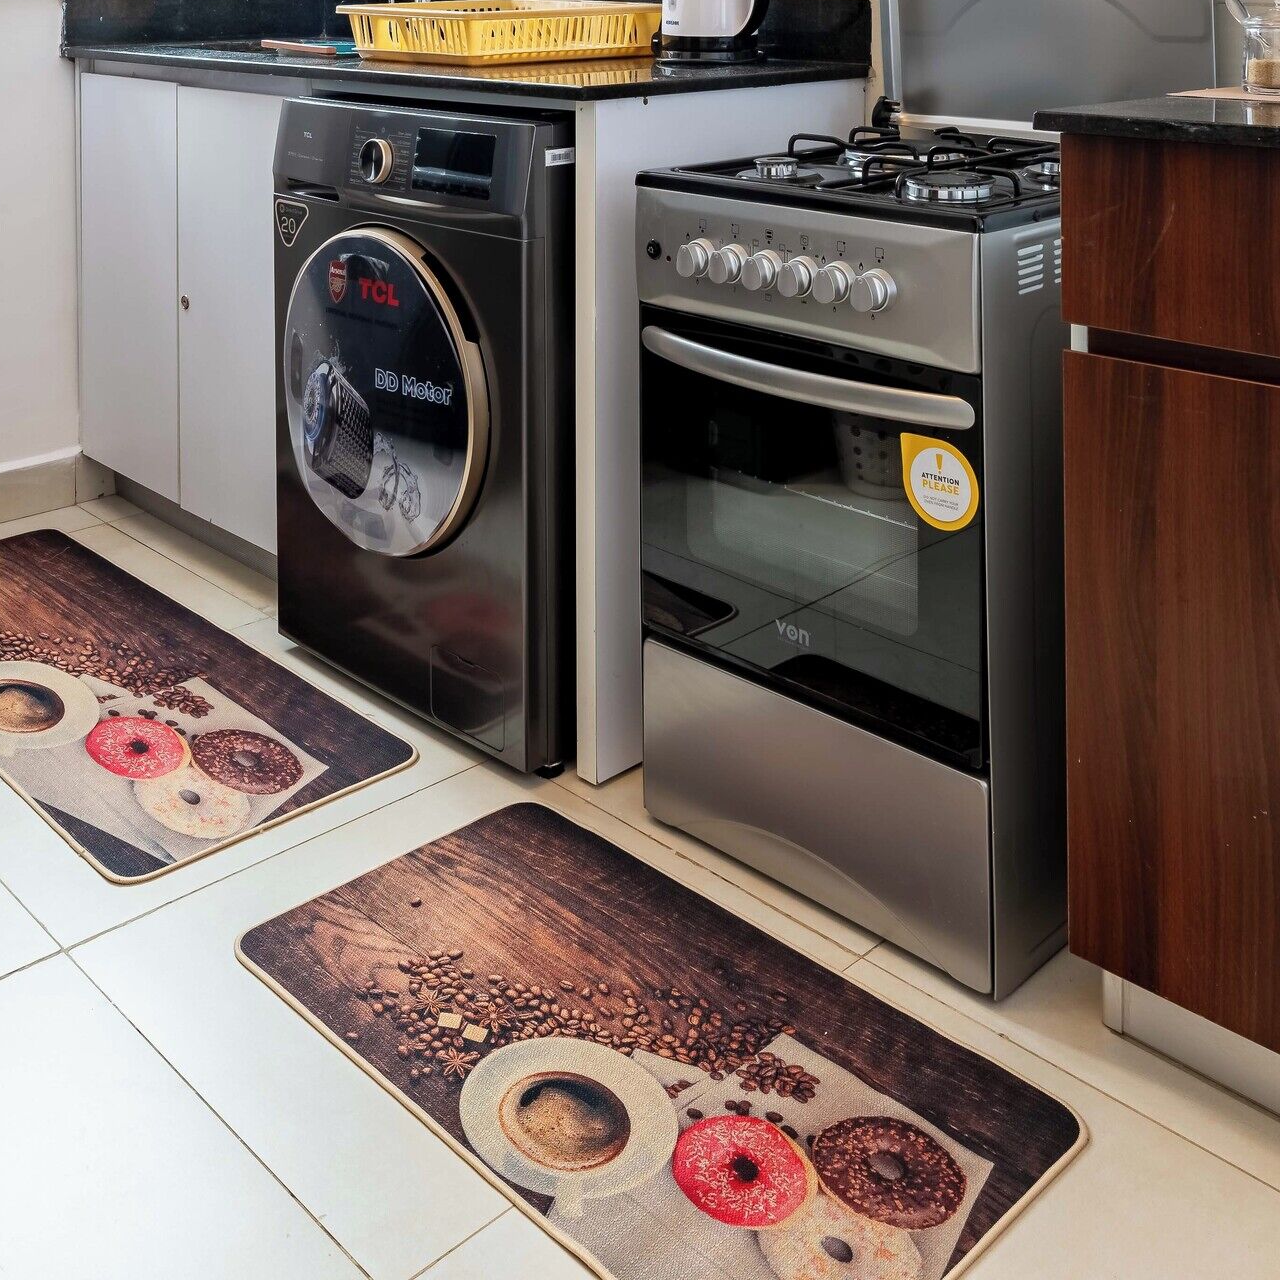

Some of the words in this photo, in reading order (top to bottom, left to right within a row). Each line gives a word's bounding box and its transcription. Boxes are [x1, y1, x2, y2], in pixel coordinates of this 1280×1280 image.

[303, 131, 313, 139] TCL
[281, 216, 296, 234] 20
[359, 277, 400, 307] TCL
[374, 368, 399, 392] DD
[401, 374, 452, 405] Motor
[921, 472, 959, 486] ATTENTION
[922, 479, 959, 495] PLEASE
